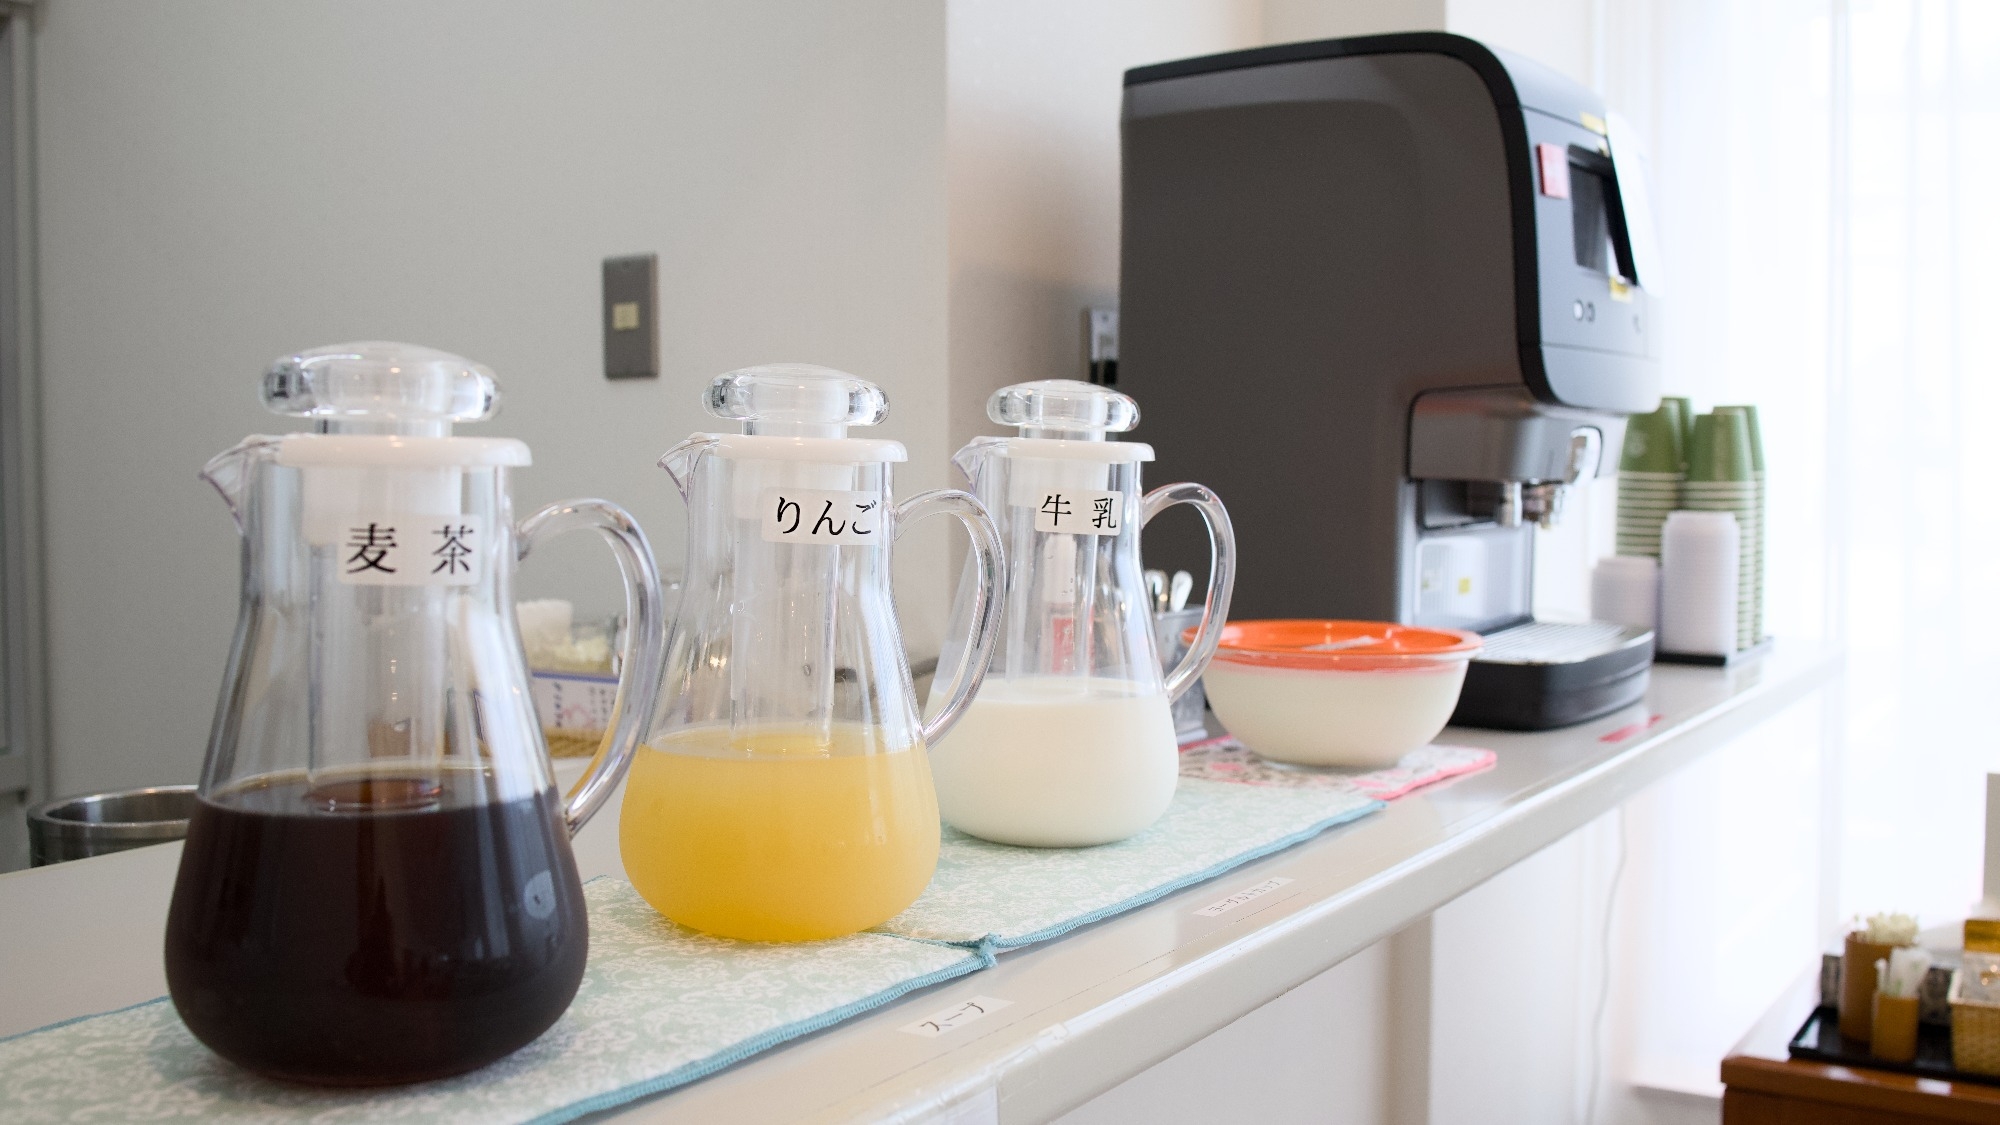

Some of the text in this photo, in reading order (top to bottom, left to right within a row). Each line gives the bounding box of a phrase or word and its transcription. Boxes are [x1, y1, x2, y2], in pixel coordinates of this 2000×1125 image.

[776, 496, 877, 536] りんご
[1040, 493, 1118, 529] 牛乳
[346, 522, 476, 575] 麦茶
[919, 1001, 984, 1032] スープ
